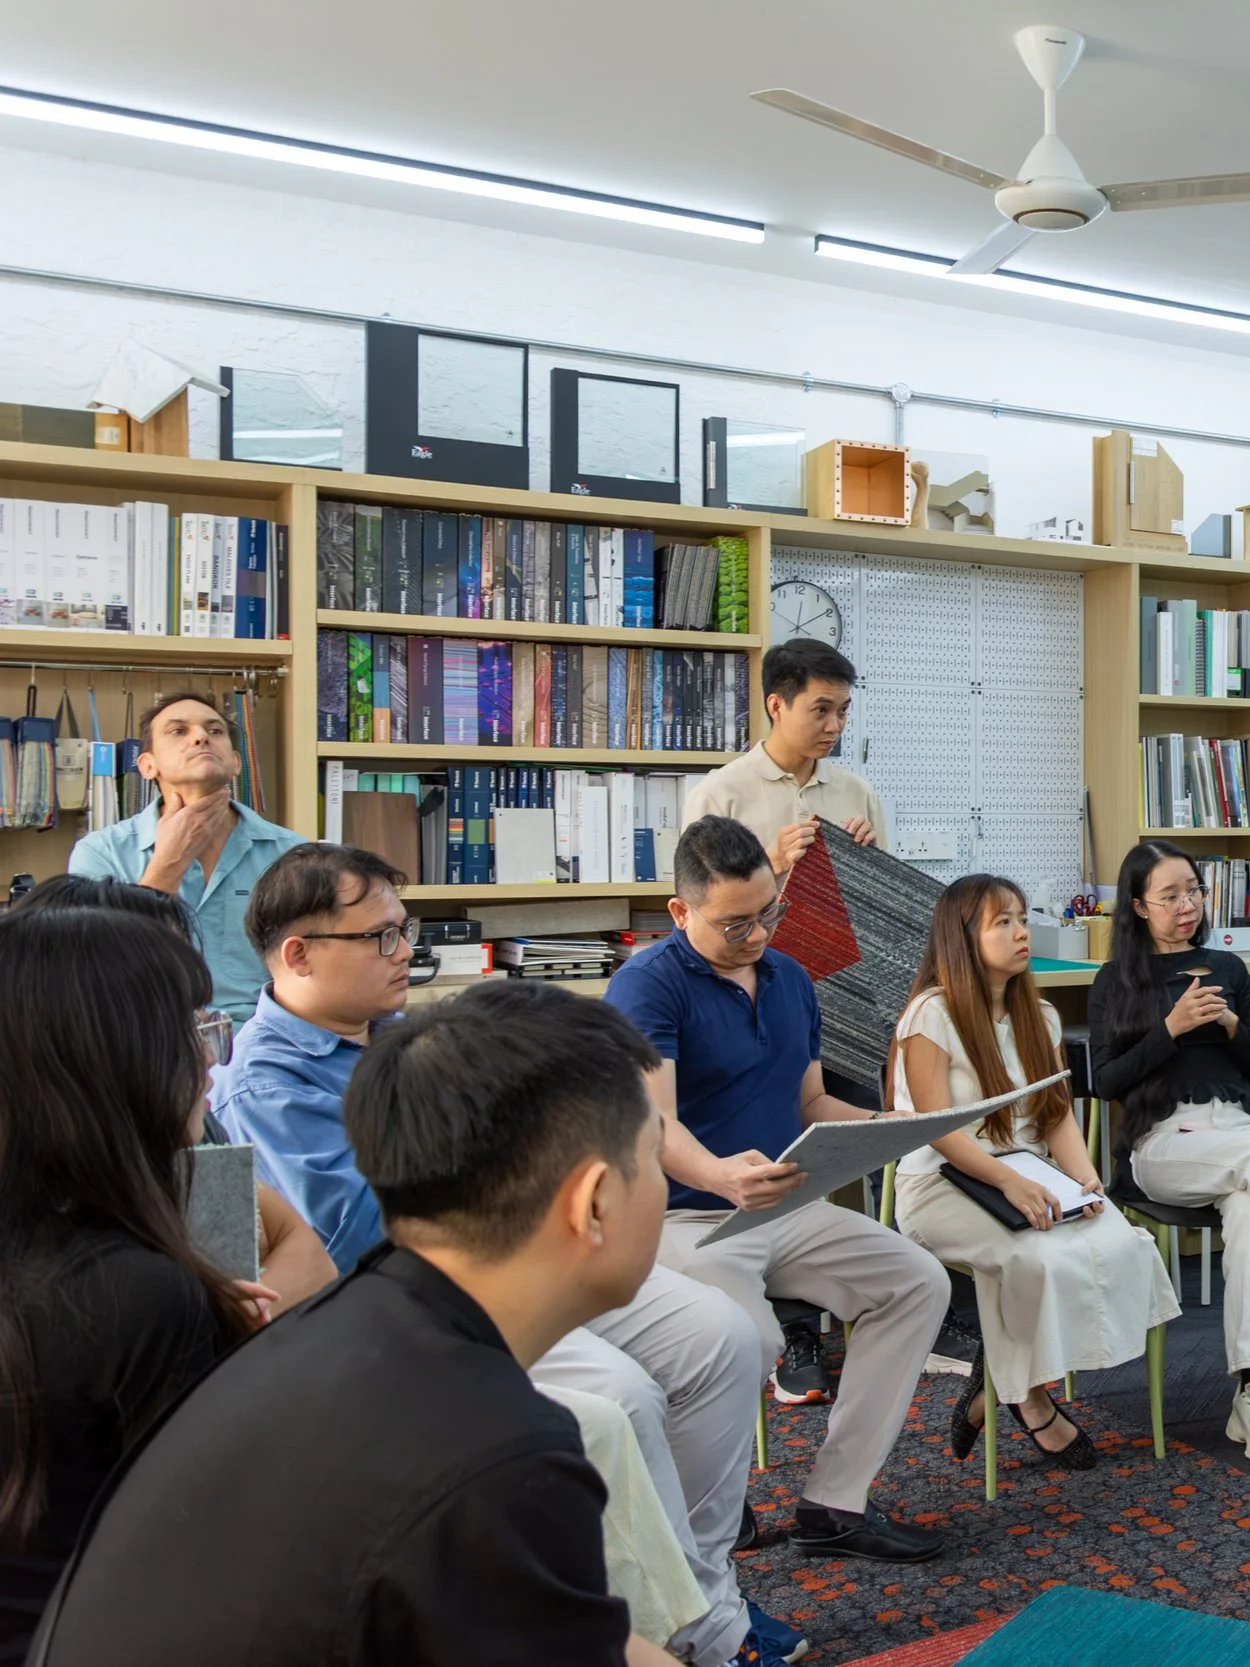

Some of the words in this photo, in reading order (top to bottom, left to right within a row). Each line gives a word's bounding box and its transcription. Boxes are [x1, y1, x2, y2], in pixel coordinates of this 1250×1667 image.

[211, 555, 219, 589] BANGKOK
[778, 590, 786, 599] 11
[795, 586, 805, 594] 12
[816, 594, 819, 603] 1
[826, 609, 833, 617] 2
[829, 627, 836, 636] 3
